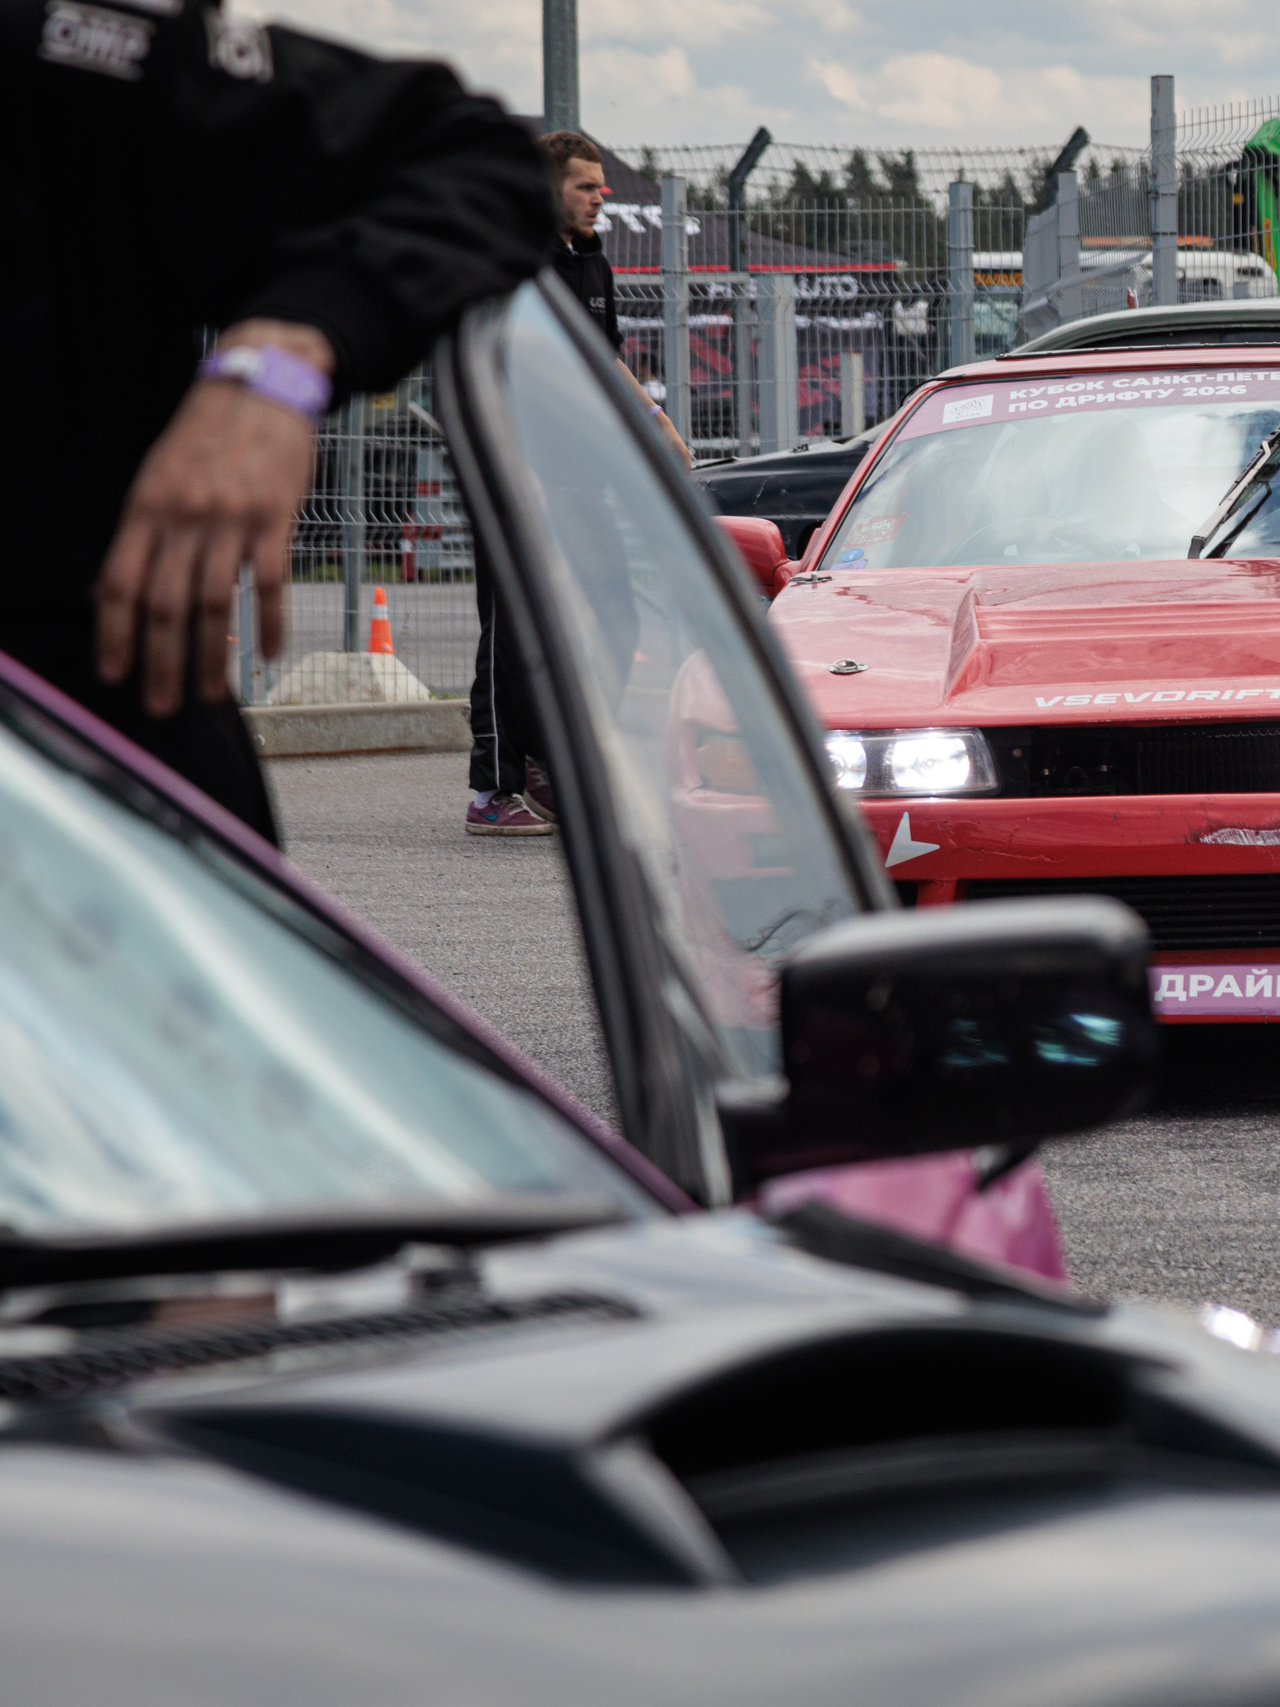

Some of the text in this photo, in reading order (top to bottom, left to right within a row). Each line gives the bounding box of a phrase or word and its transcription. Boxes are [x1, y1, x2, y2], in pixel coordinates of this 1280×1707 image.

[1008, 385, 1247, 413] ПО ДРИФТУ 2026
[1009, 380, 1105, 400] КУБОК
